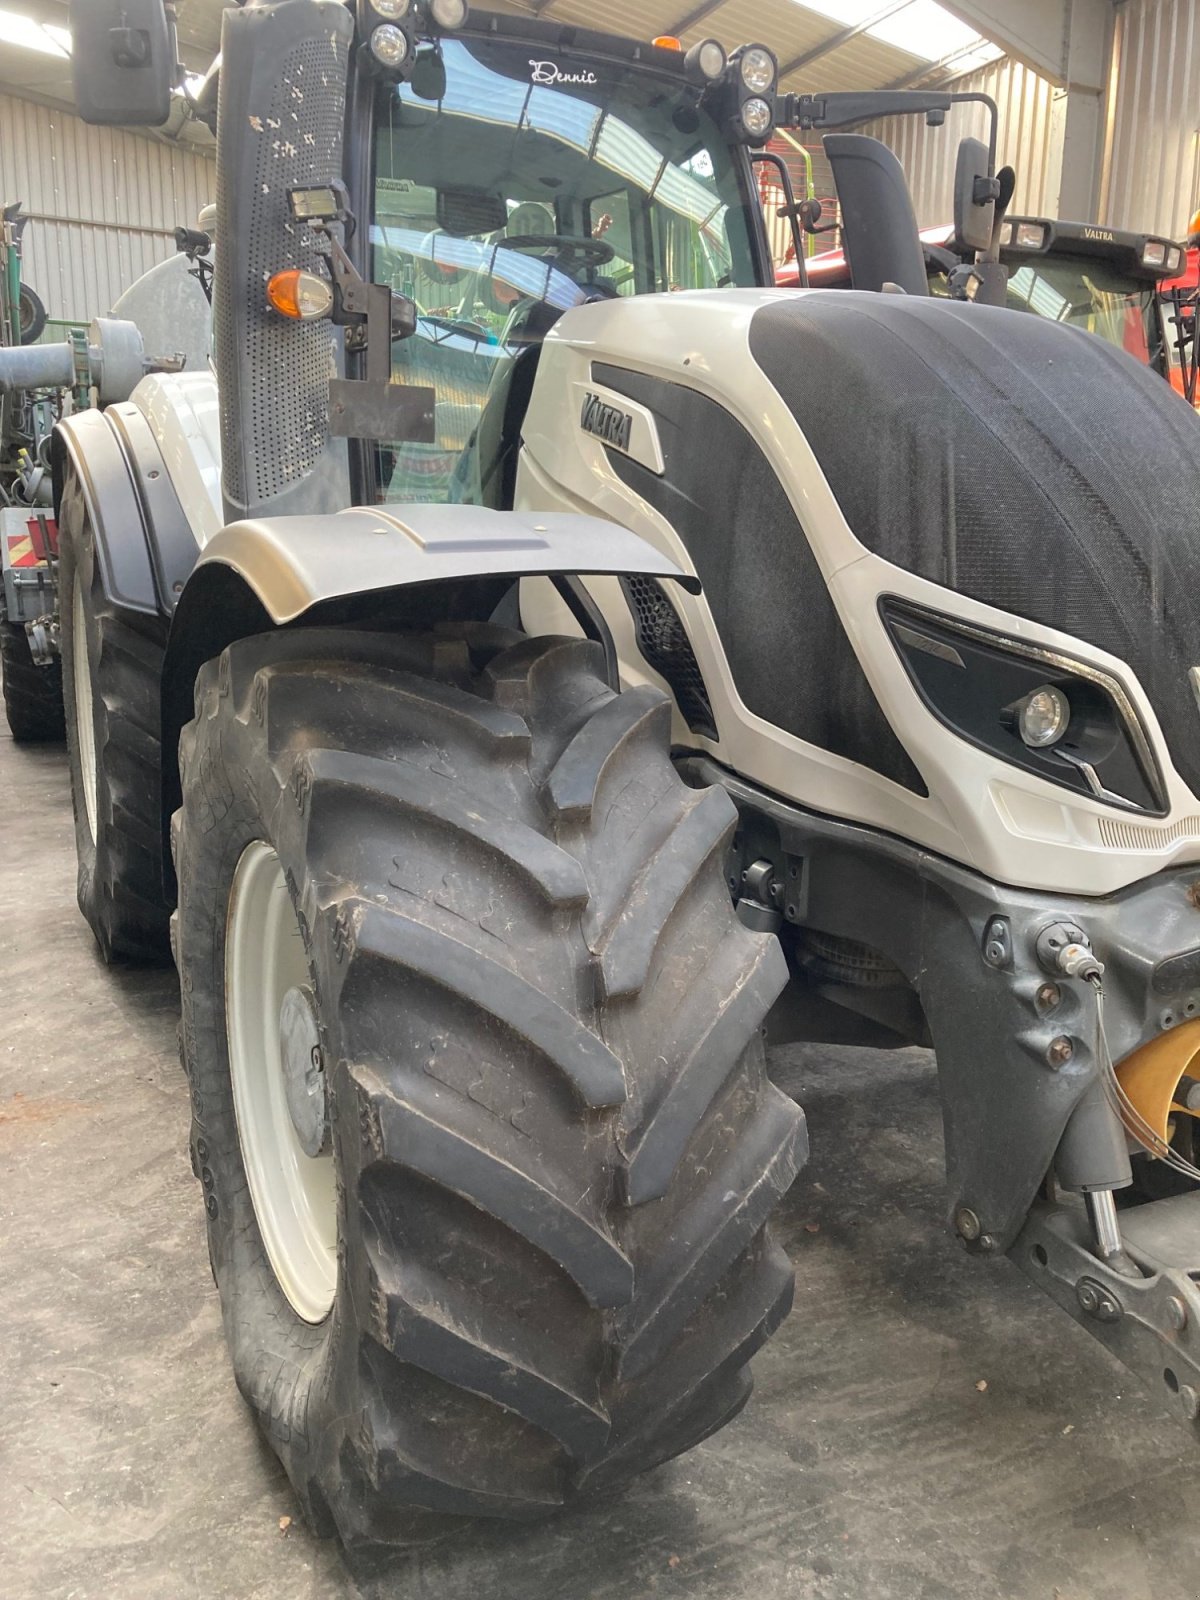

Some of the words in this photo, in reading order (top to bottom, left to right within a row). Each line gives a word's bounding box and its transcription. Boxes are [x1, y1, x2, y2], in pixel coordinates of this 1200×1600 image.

[528, 60, 598, 85] Dennis
[1084, 228, 1113, 241] VALTRA
[580, 392, 633, 452] VALTRA
